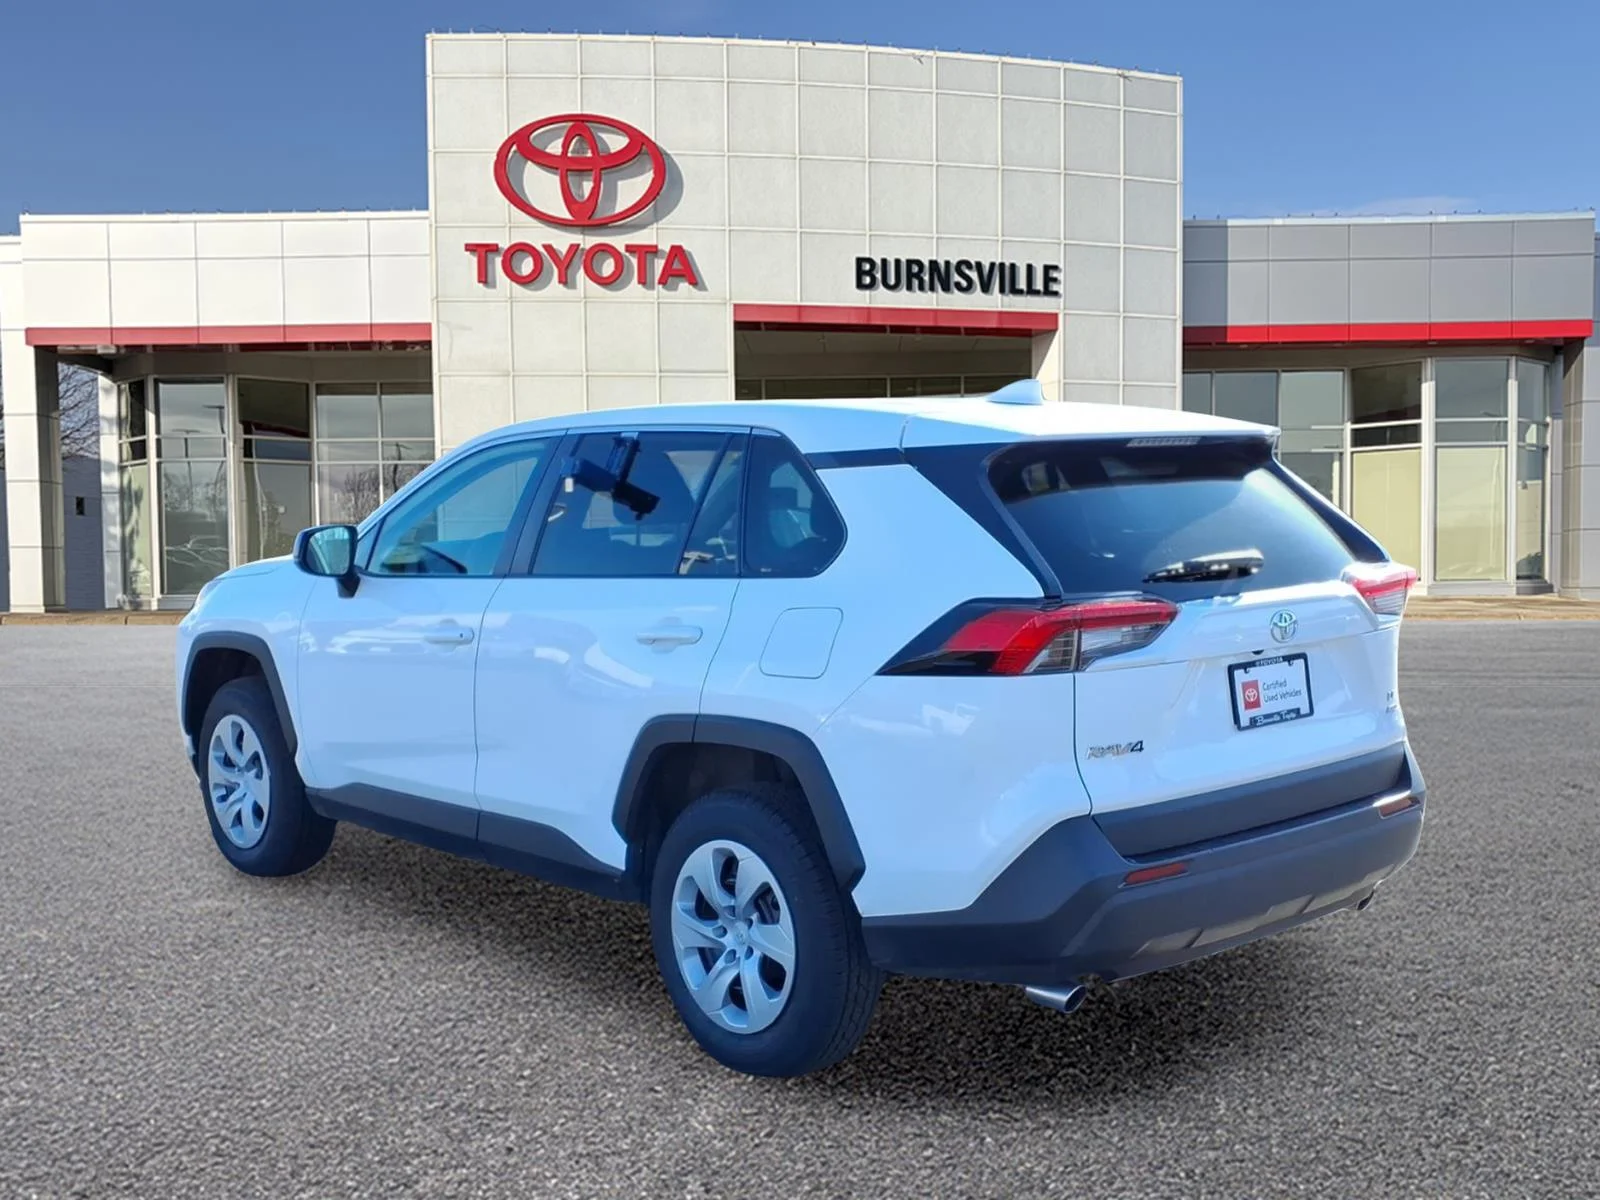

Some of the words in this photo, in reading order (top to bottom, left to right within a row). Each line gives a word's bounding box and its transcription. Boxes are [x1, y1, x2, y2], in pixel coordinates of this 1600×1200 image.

[464, 242, 698, 286] TOYOTA
[855, 257, 1060, 297] BURNSVILLE
[1262, 678, 1287, 690] Certified
[1263, 693, 1279, 703] Used
[1279, 689, 1302, 700] Vehicles
